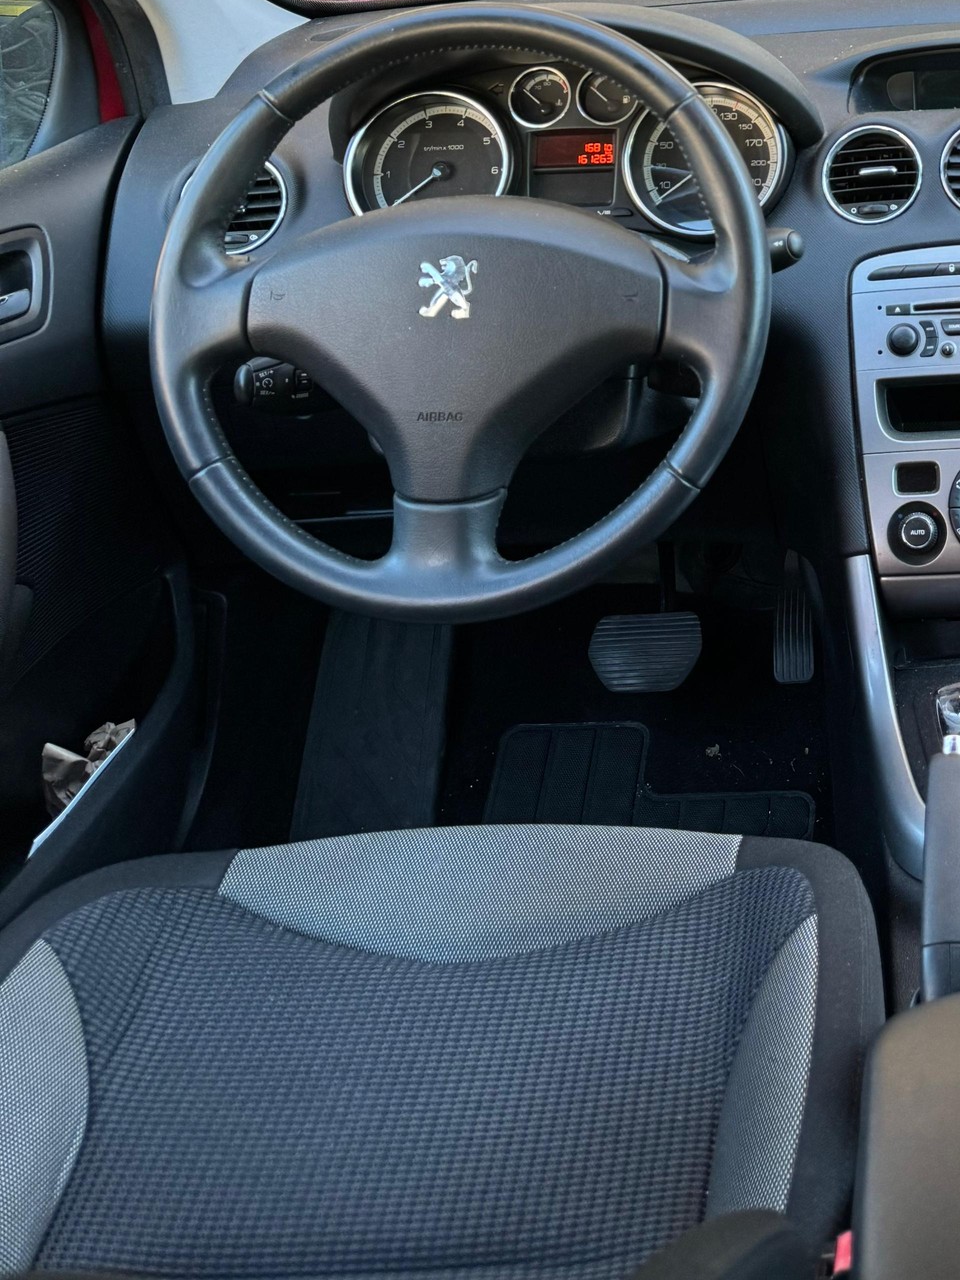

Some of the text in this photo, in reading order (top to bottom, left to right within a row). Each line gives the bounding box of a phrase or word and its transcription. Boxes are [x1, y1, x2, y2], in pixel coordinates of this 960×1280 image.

[719, 112, 738, 120] 130
[425, 120, 433, 129] 3
[456, 119, 465, 127] 4
[397, 140, 406, 149] 2
[482, 137, 491, 145] 5
[659, 141, 674, 150] 50
[744, 138, 763, 147] 170
[386, 170, 391, 178] 1
[491, 166, 499, 175] 6
[658, 180, 671, 189] 10
[416, 411, 463, 422] AIRBAG
